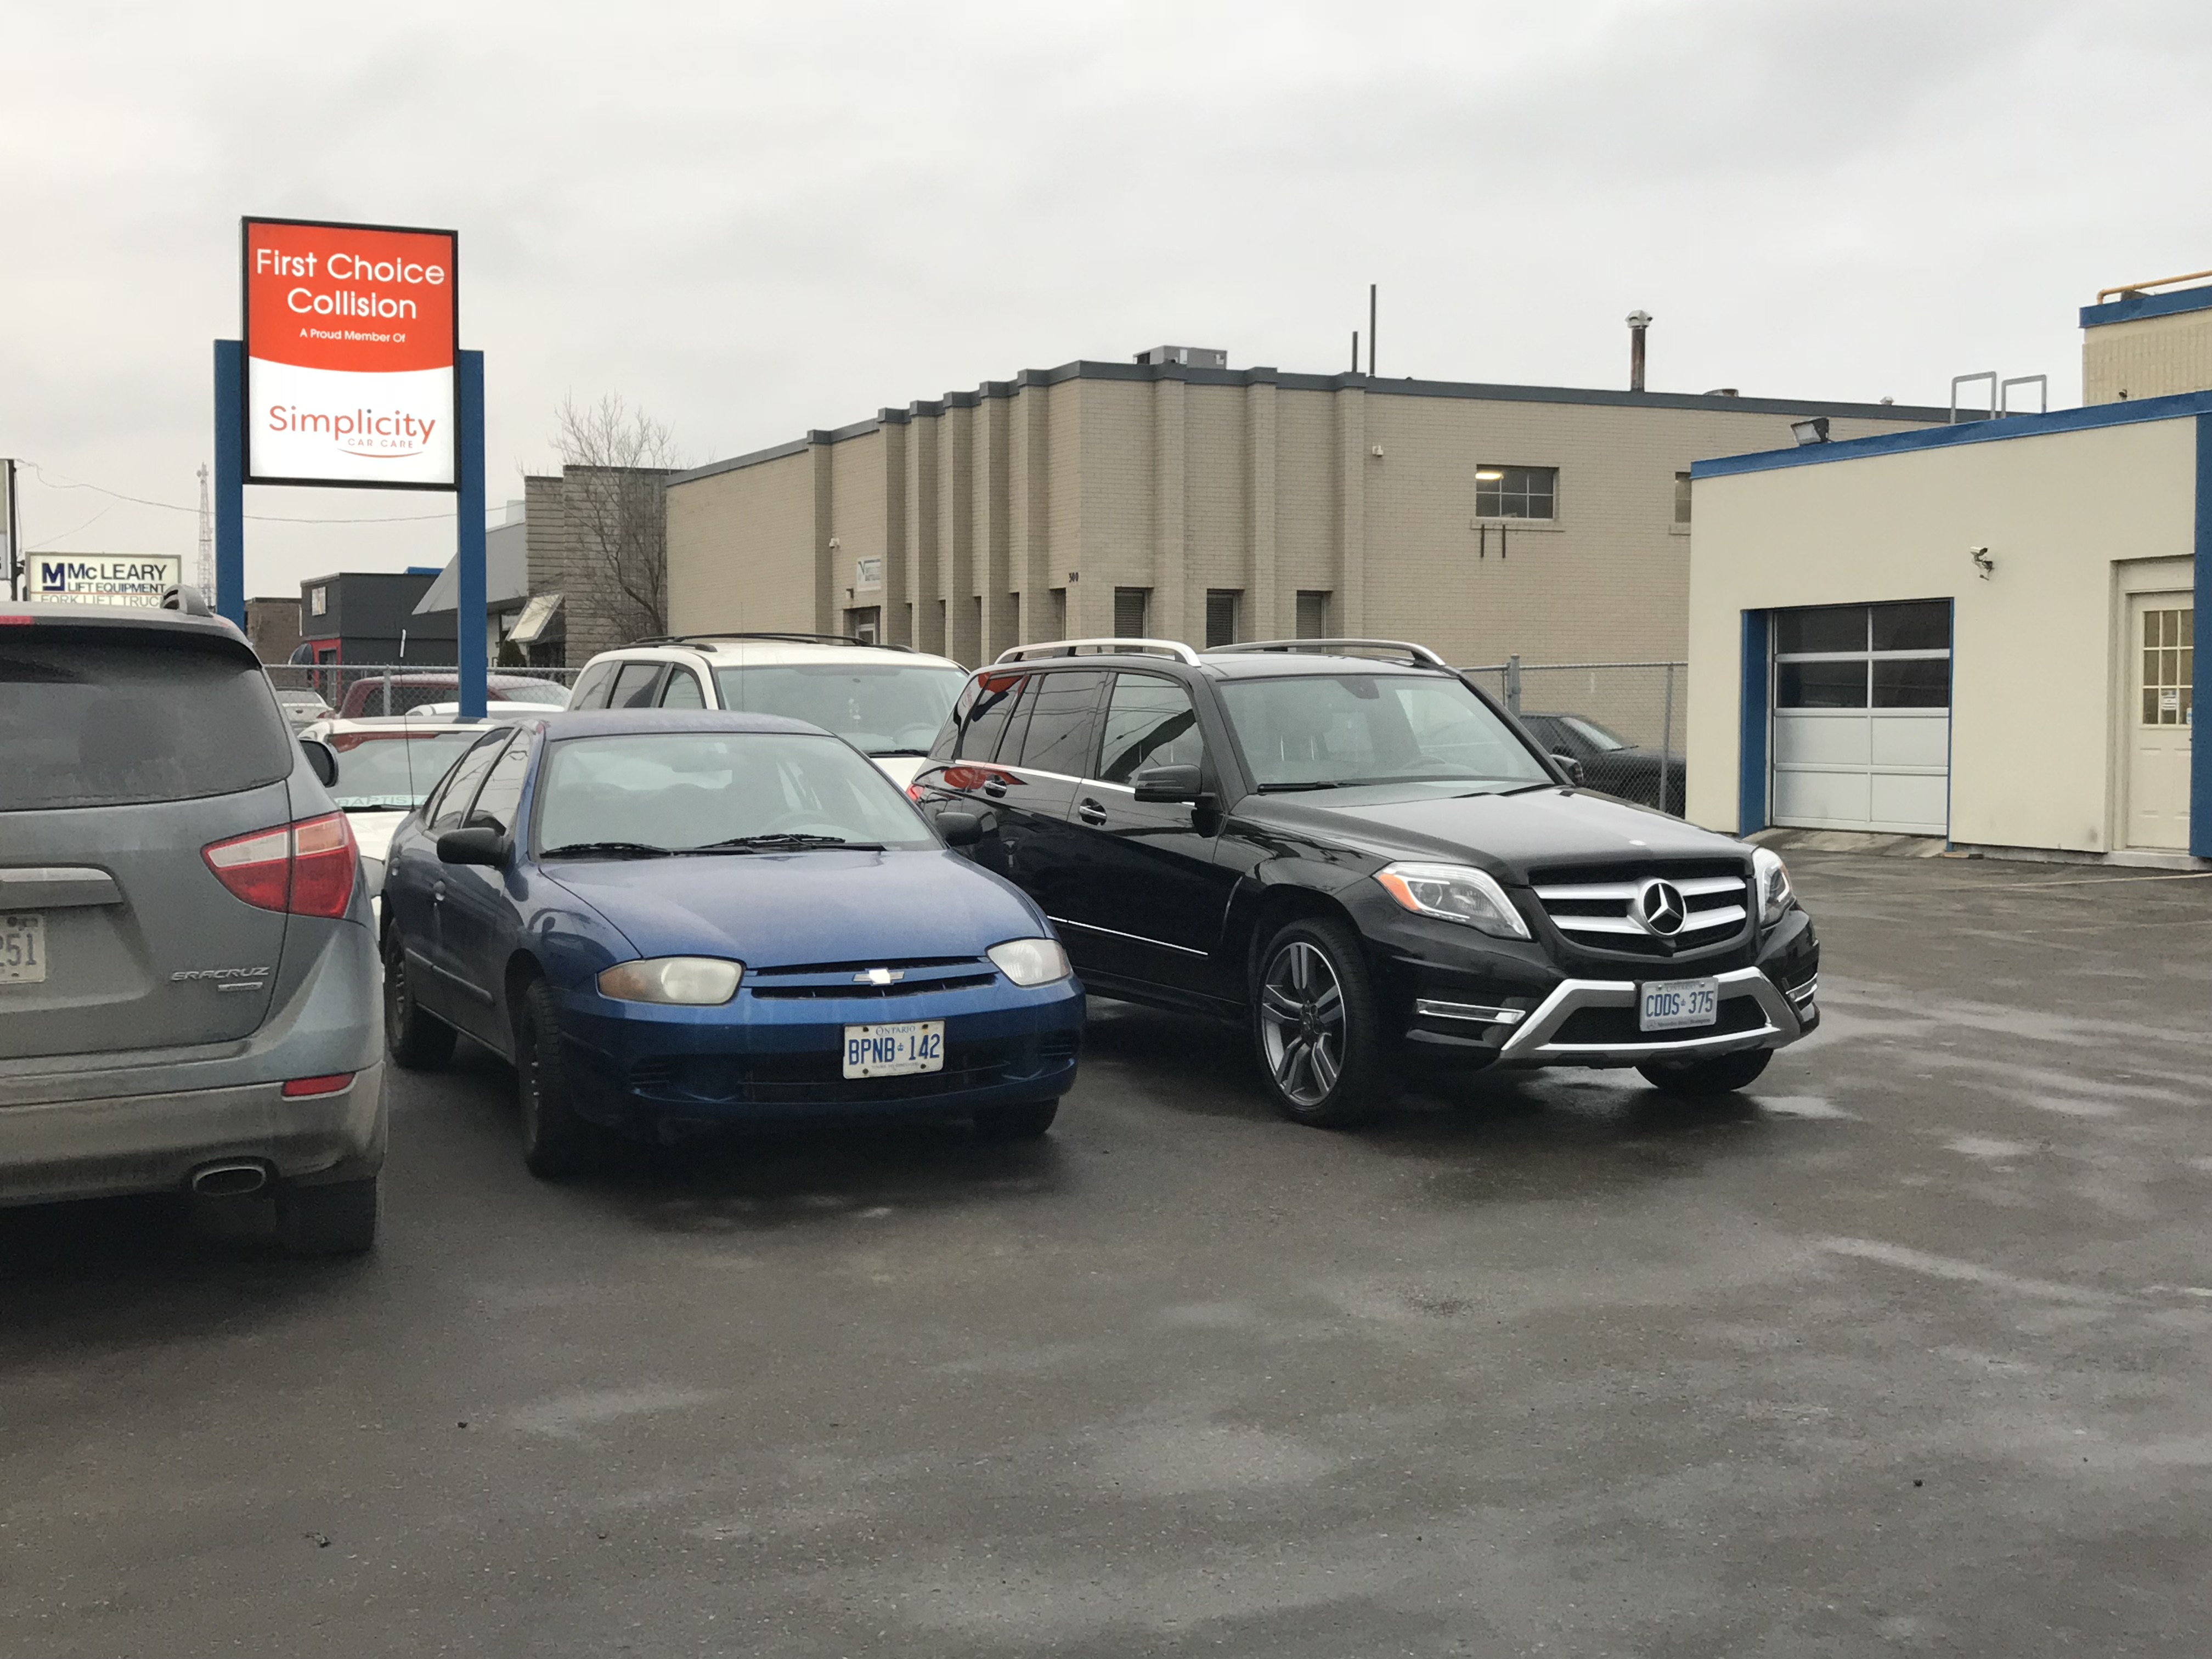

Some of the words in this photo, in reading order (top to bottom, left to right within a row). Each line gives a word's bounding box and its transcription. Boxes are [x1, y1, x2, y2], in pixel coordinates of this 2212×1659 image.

[257, 249, 317, 276] First
[327, 253, 445, 285] Choice
[287, 287, 416, 319] Collision
[300, 328, 308, 338] A
[310, 329, 342, 340] Proud
[345, 330, 390, 342] Member
[393, 333, 406, 343] Of
[269, 405, 436, 445] Simplicity
[348, 438, 374, 447] CAR
[380, 439, 413, 449] CARE
[67, 582, 94, 592] LIFT
[95, 583, 167, 594] EQUIPMENT
[121, 596, 163, 607] TRUC
[1646, 993, 1680, 1017] CDDS
[1688, 991, 1714, 1014] 375
[876, 1025, 916, 1036] ONTARIO
[849, 1037, 895, 1065] BPNB
[909, 1033, 940, 1060] 142
